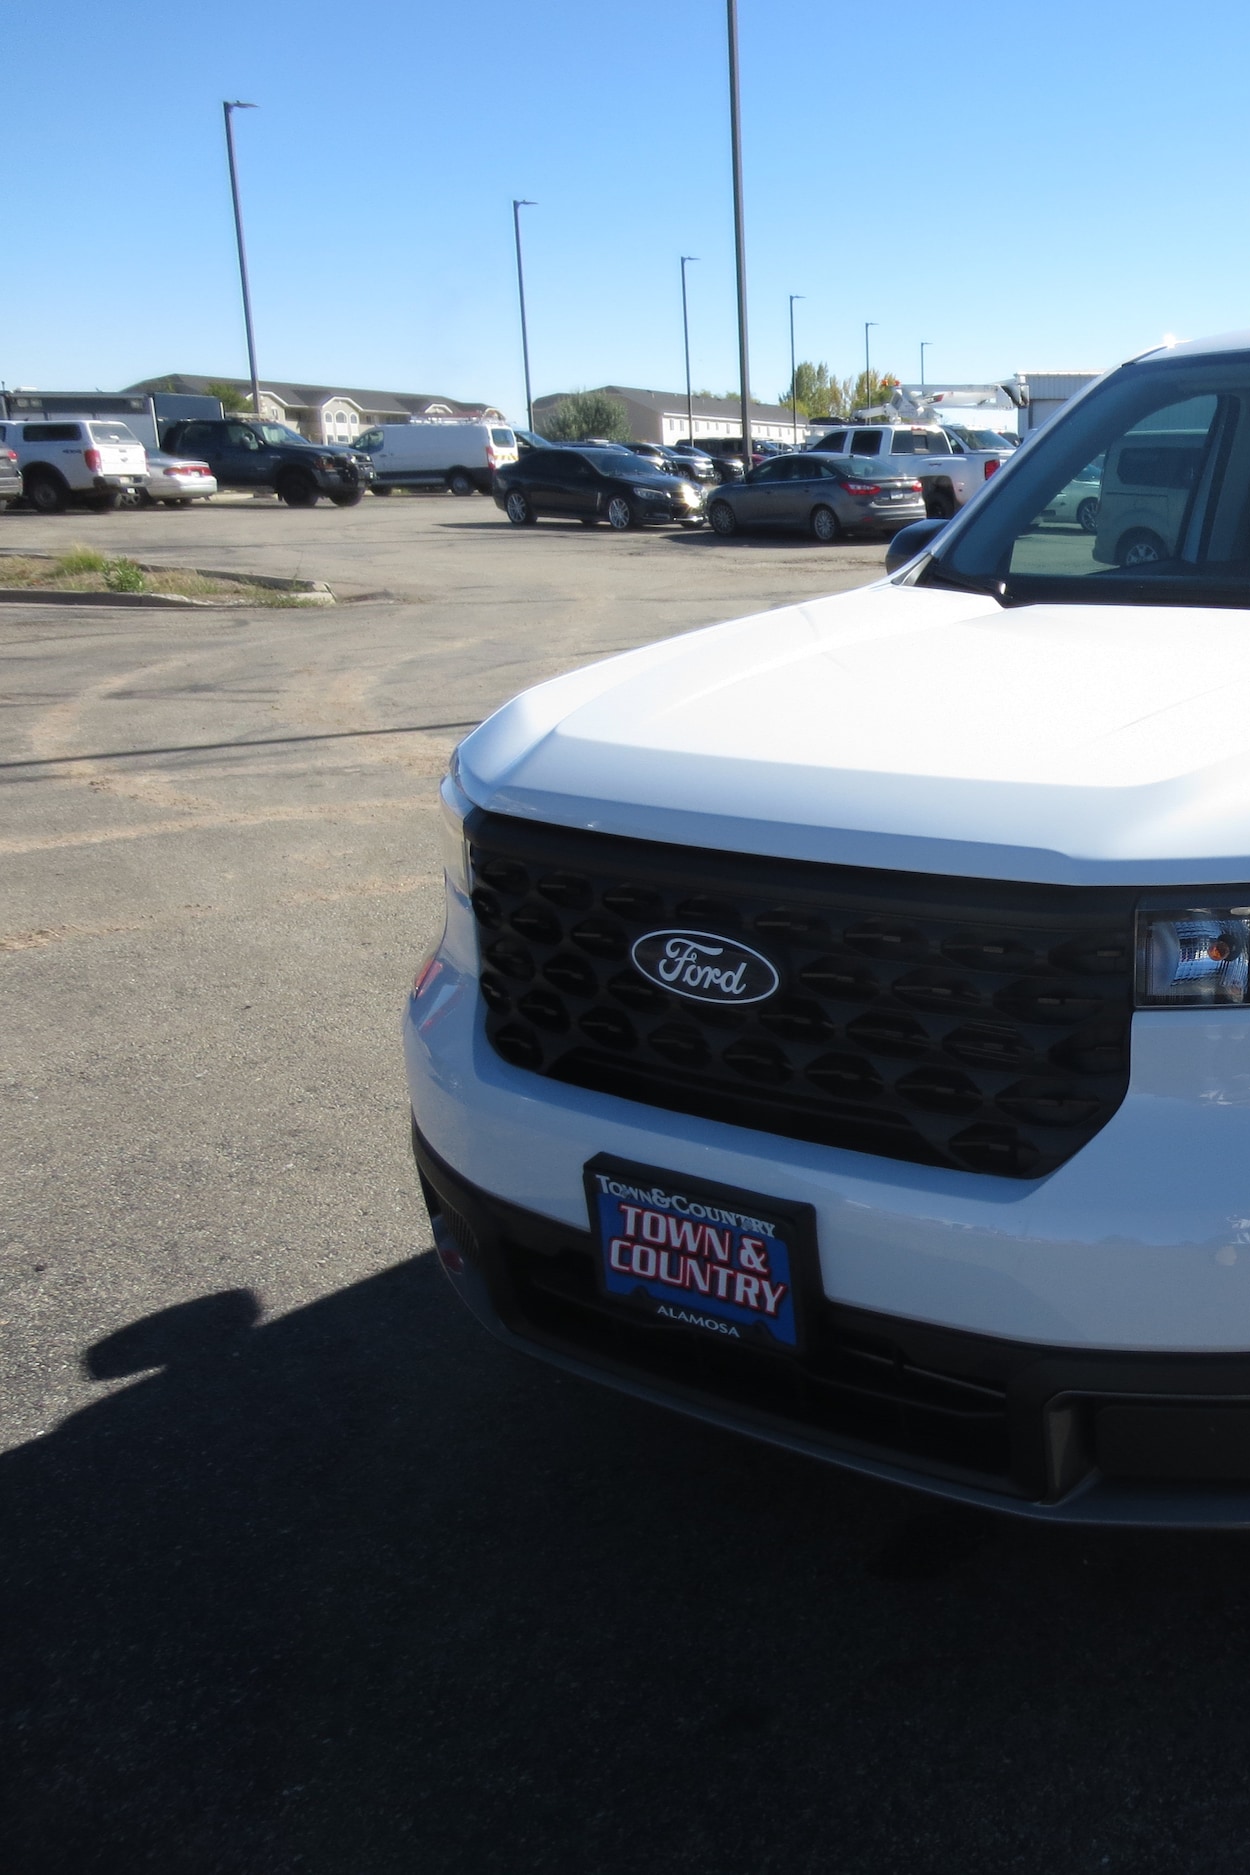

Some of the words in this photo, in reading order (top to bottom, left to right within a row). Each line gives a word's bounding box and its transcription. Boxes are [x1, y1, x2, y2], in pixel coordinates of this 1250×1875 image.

[658, 937, 748, 995] Ford
[619, 1203, 731, 1264] TOWN
[739, 1235, 769, 1274] &
[609, 1238, 786, 1315] COUNTRY
[656, 1304, 741, 1338] ALAMOSA
